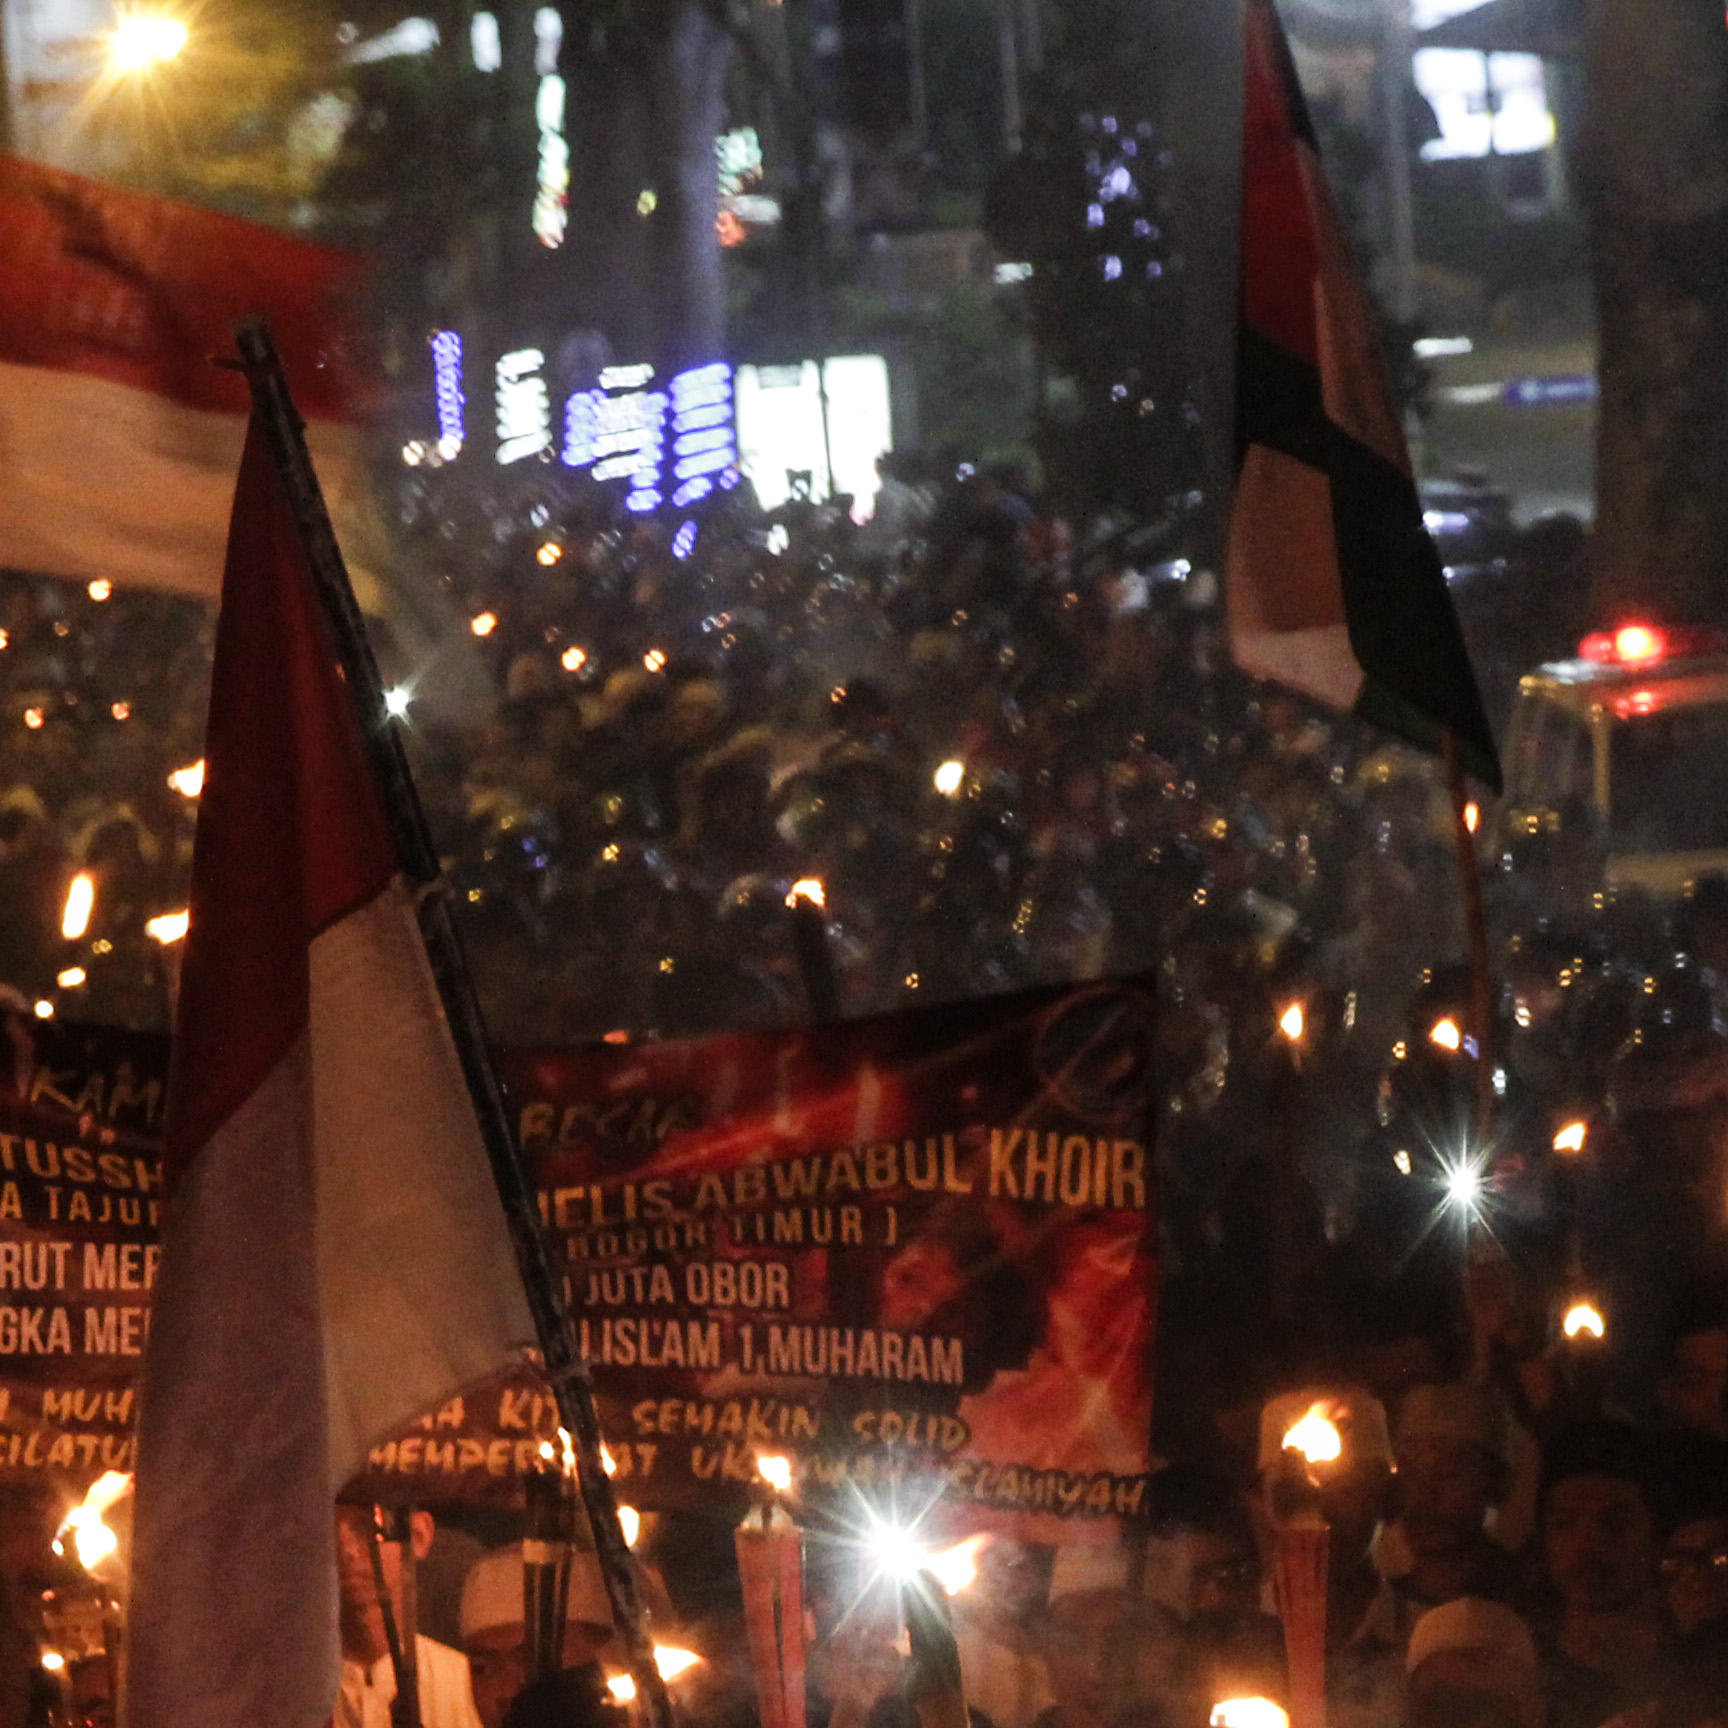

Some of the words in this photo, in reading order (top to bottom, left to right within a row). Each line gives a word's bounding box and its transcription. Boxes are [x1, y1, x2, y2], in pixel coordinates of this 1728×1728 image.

[30, 1065, 161, 1125] KAM
[692, 1132, 974, 1211] ABWABUL
[987, 1127, 1147, 1209] KHOIR
[733, 1205, 864, 1246] TIMUR
[584, 1263, 676, 1306] JUTA
[685, 1260, 789, 1309] OBOR
[84, 1307, 152, 1356] ME
[602, 1317, 721, 1369] ISLAM
[767, 1323, 964, 1385] MUHARAM
[42, 1387, 136, 1424] MUH
[632, 1398, 821, 1440] SEMAKIN
